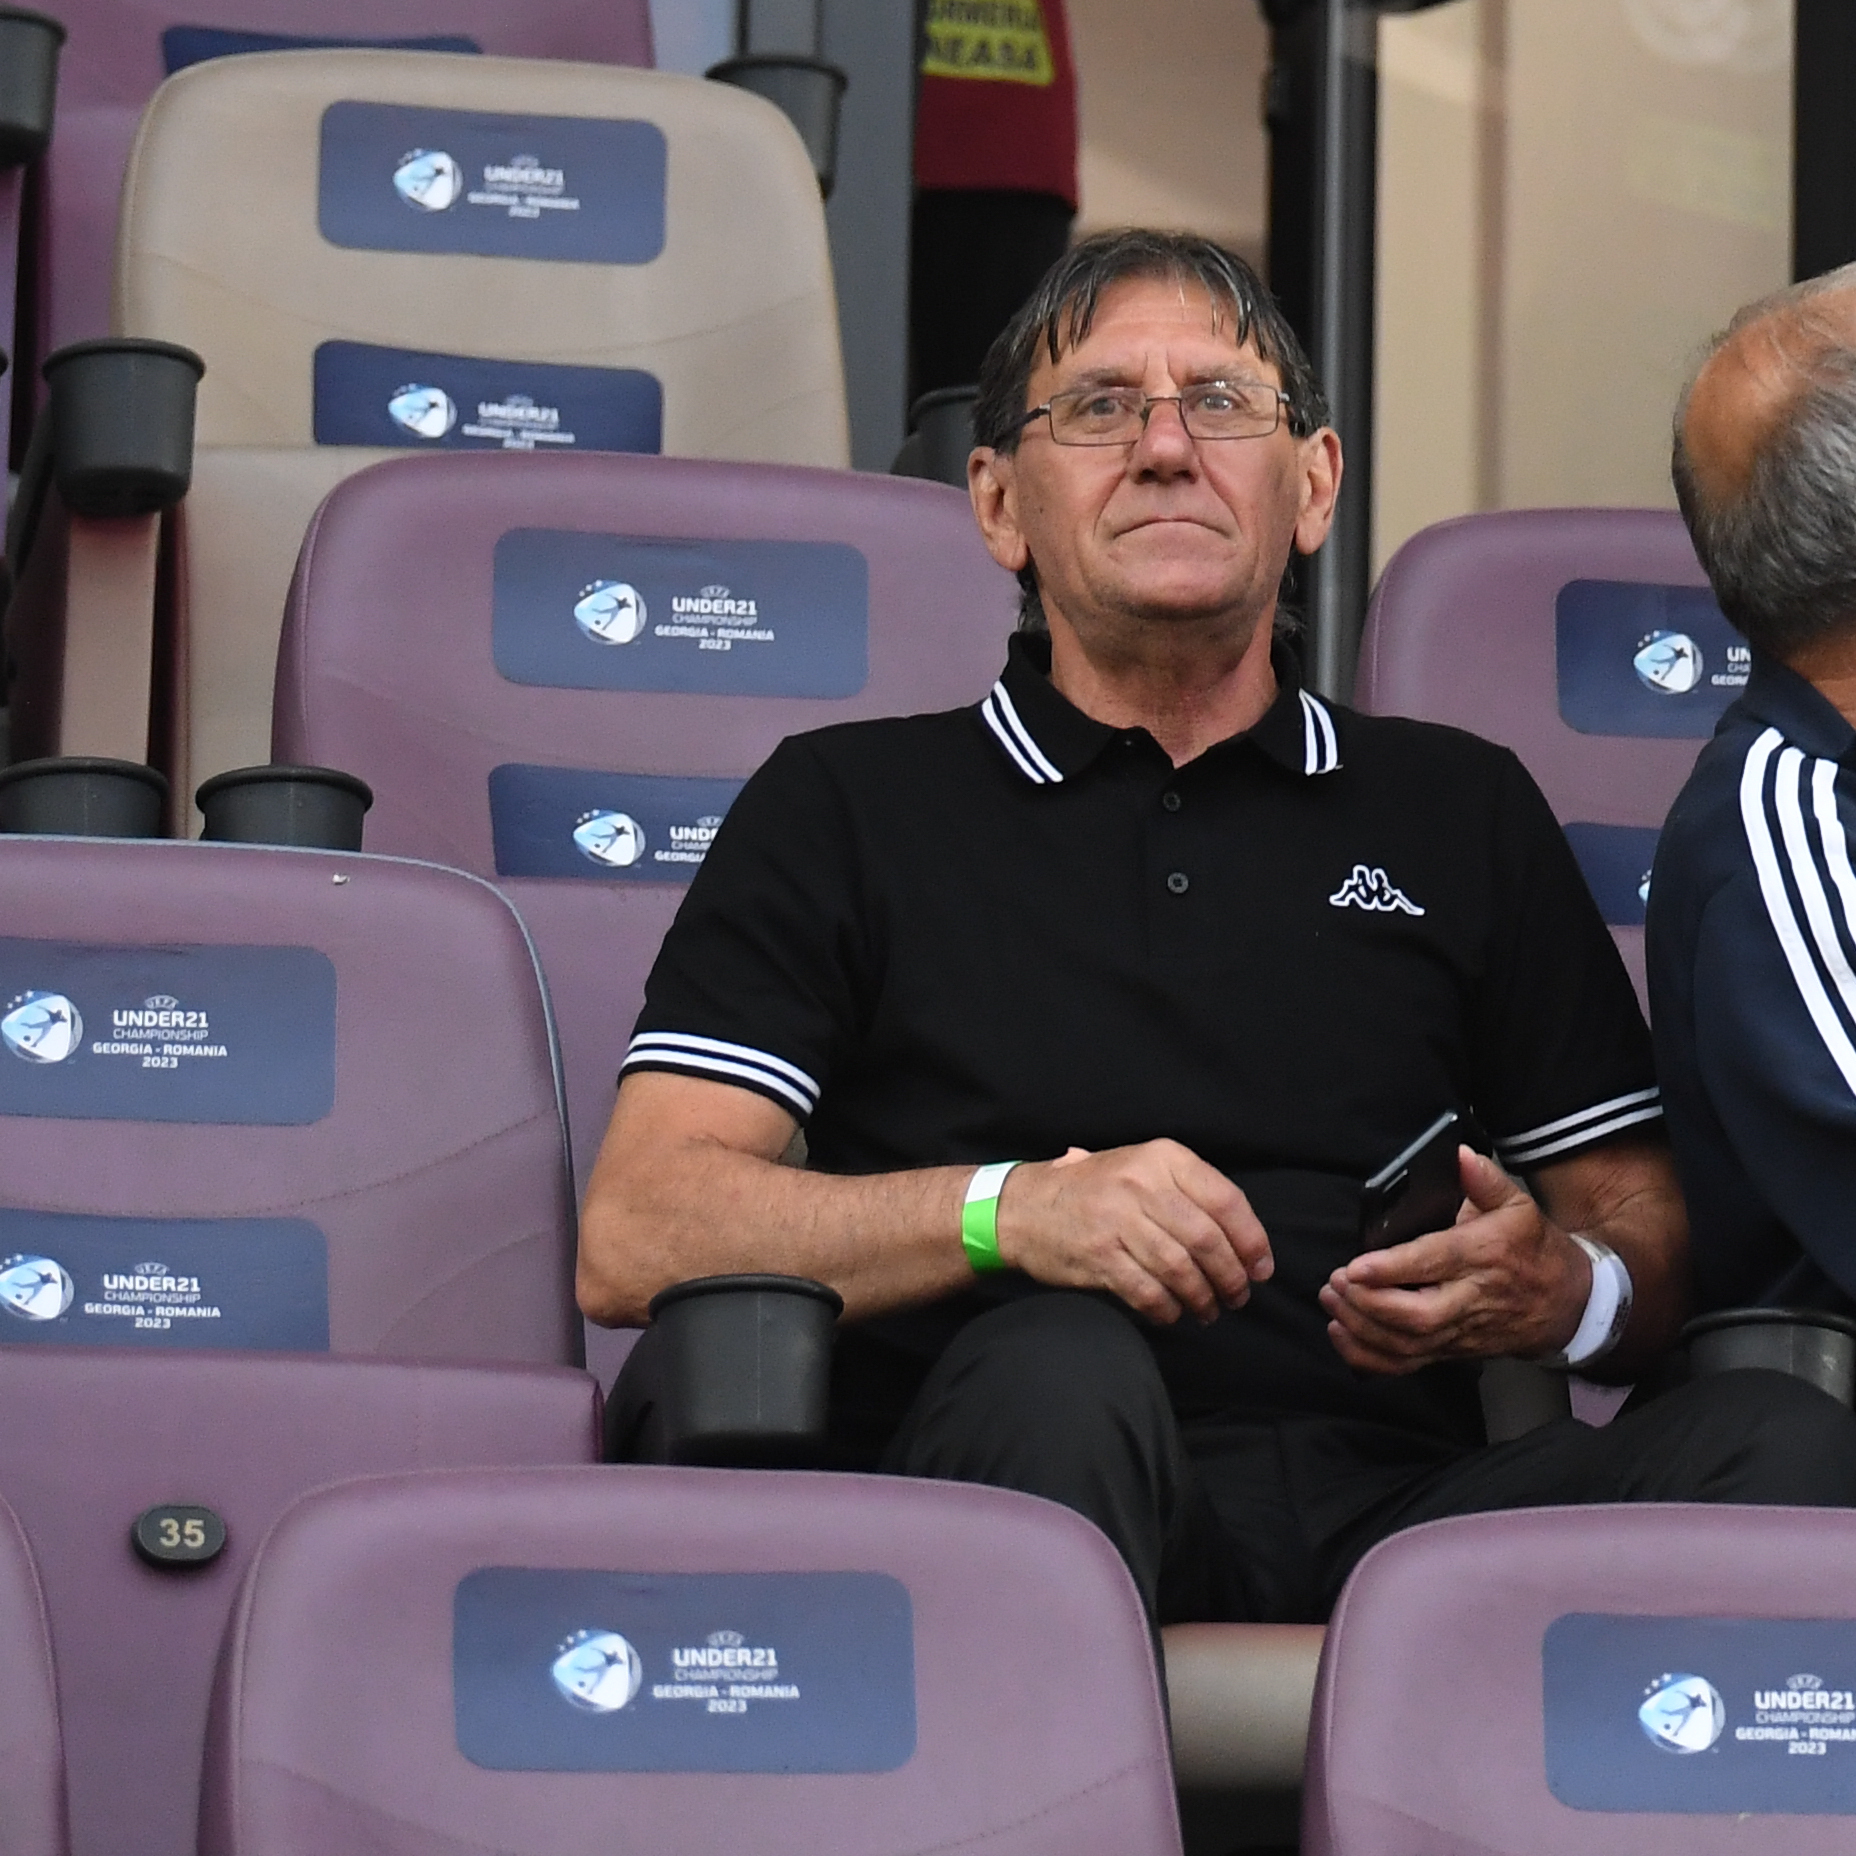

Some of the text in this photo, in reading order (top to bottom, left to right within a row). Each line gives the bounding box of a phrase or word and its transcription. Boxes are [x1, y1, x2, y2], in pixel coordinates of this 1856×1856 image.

[672, 596, 757, 615] UNDER21
[717, 627, 775, 641] ROMANIA
[699, 638, 731, 651] 2023
[113, 1010, 209, 1028] UNDER21
[113, 1028, 209, 1041] CHAMPIONSHIP
[93, 1042, 152, 1055] GEORGIA
[163, 1044, 228, 1057] ROMANIA
[142, 1056, 178, 1069] 2023
[103, 1274, 201, 1292] UNDER21
[104, 1291, 201, 1305] CHAMPIONSHIP
[84, 1302, 145, 1316] GEORGIA
[155, 1306, 221, 1318] ROMANIA
[134, 1317, 171, 1329] 2023
[159, 1517, 206, 1549] 35
[673, 1647, 778, 1667] UNDER21
[1754, 1690, 1856, 1711] UNDER21
[1735, 1726, 1800, 1741] GEORGIA
[1788, 1741, 1827, 1755] 2023
